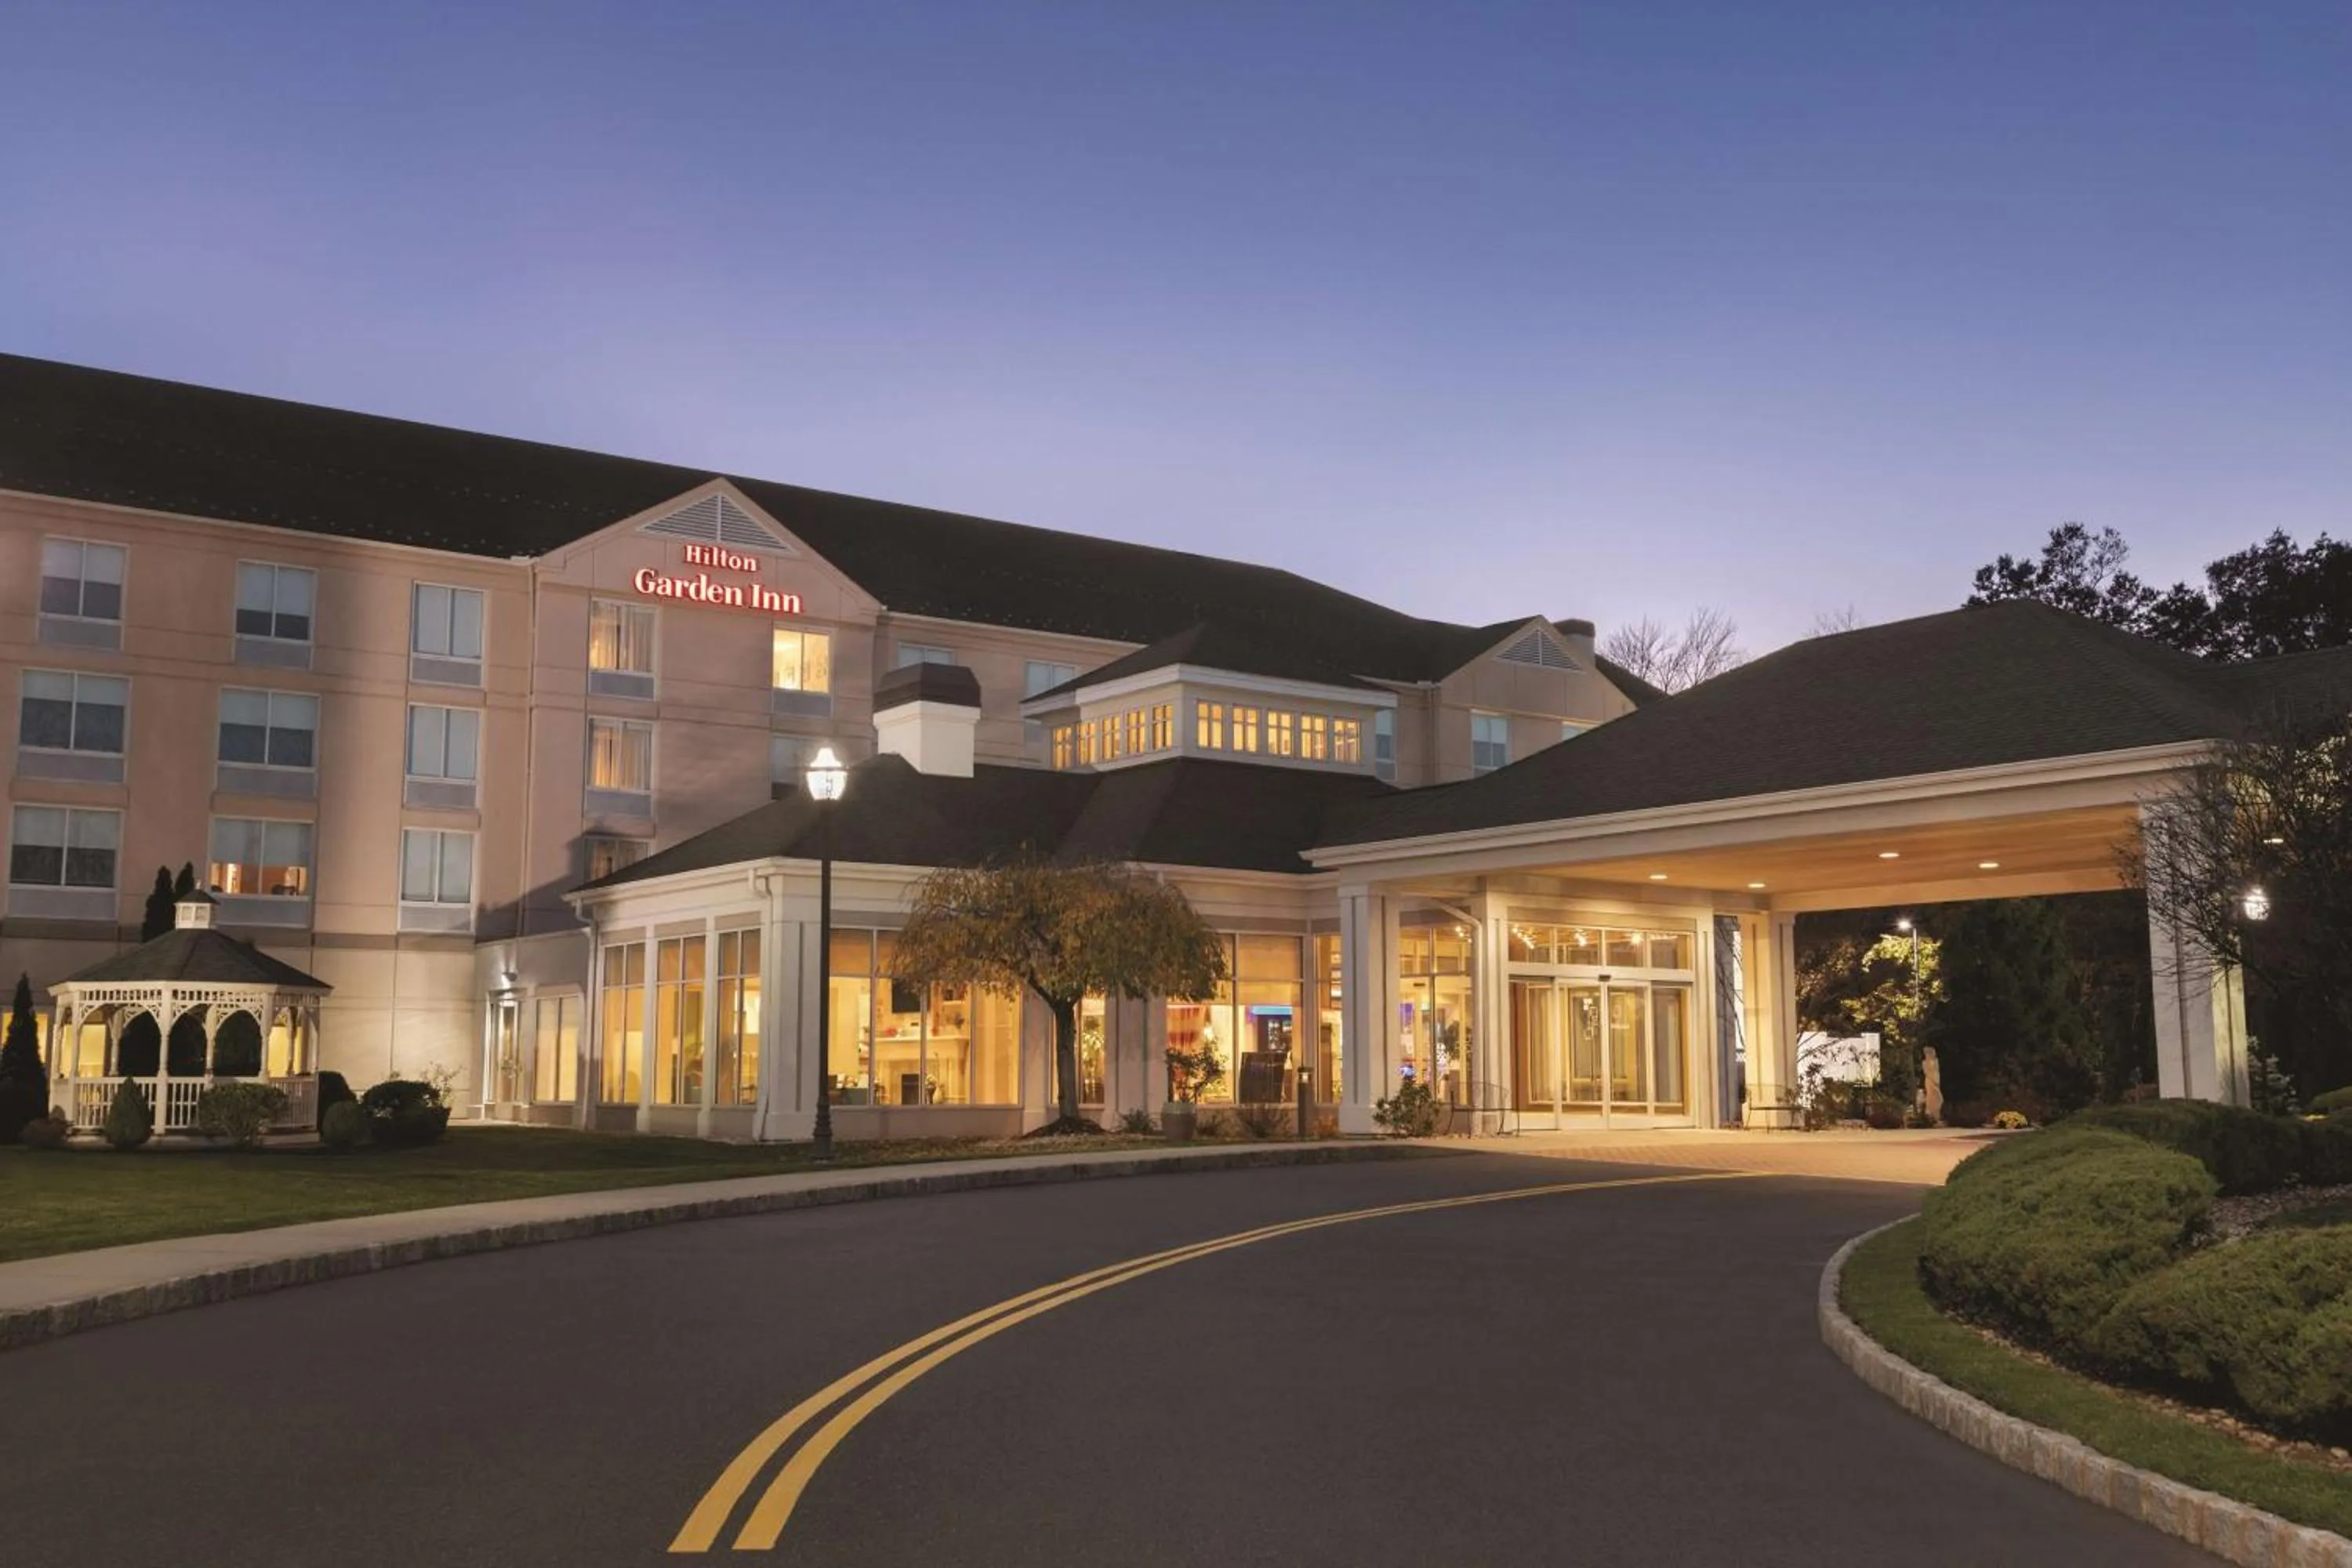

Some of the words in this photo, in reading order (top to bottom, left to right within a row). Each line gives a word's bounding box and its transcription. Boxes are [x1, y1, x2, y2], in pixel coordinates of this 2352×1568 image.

[684, 544, 759, 572] Hilton
[634, 568, 743, 606] Garden
[750, 583, 802, 614] Inn
